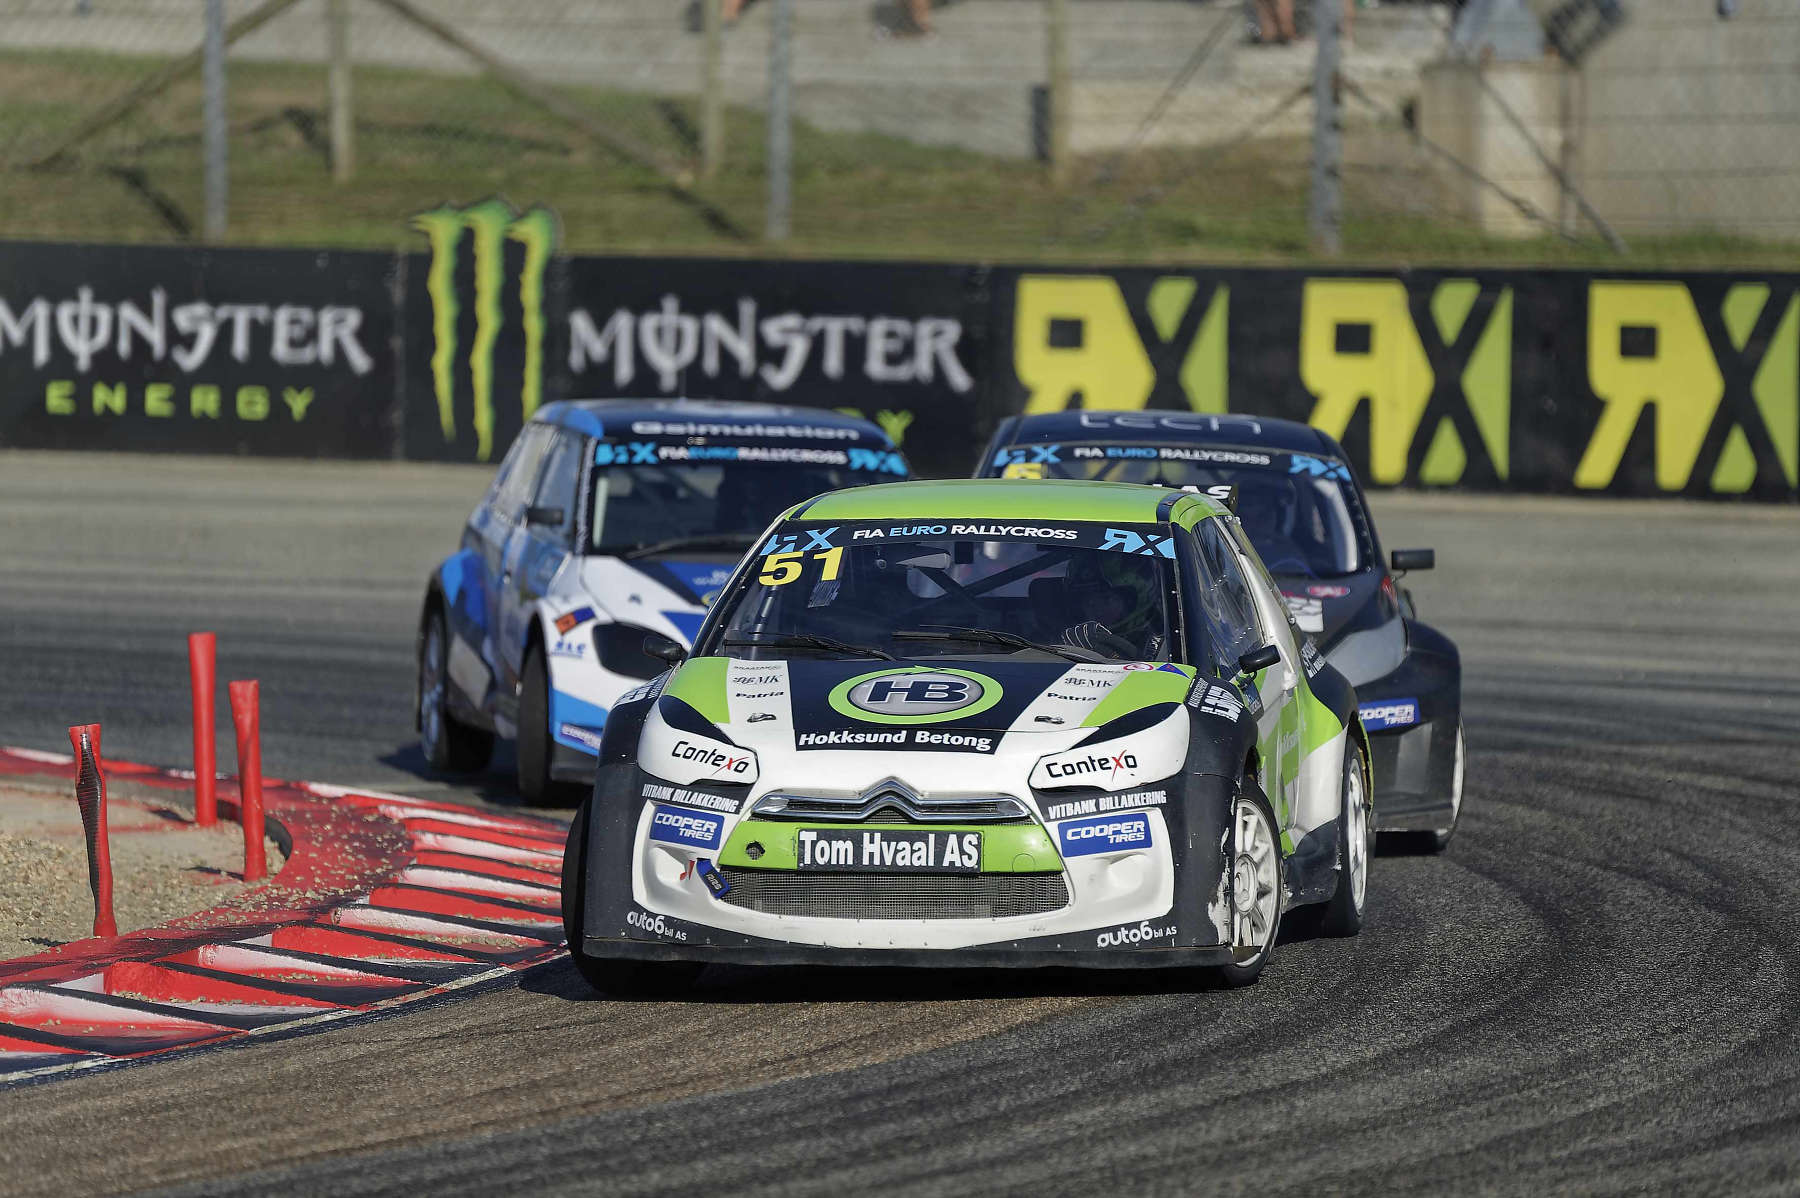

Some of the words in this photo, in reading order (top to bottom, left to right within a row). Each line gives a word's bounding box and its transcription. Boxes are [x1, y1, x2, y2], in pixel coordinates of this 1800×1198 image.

[0, 285, 374, 376] MONSTER
[568, 293, 975, 393] MONSTER
[45, 380, 315, 421] ENERGY
[1074, 447, 1104, 458] FIA
[1106, 448, 1158, 459] EURO
[1159, 448, 1271, 466] RALLYCROSS
[853, 527, 885, 541] FIA
[889, 524, 947, 538] EURO
[951, 524, 1078, 540] RALLYCROSS
[758, 546, 844, 587] 51
[735, 690, 785, 699] Patria
[865, 679, 969, 704] HB
[1047, 692, 1097, 702] Patria
[799, 730, 908, 746] Hokksund
[915, 730, 993, 751] Betong
[672, 787, 740, 813] BILLAKKERING
[1048, 799, 1097, 820] VITBANK
[1098, 790, 1168, 811] BILLAKKERING
[654, 812, 718, 833] COOPER
[1066, 820, 1145, 841] COOPER
[679, 827, 714, 841] TIRES
[1108, 833, 1145, 844] TIRES
[799, 831, 854, 865] Tom
[862, 832, 936, 867] Hvaal
[942, 833, 979, 868] AS
[675, 930, 687, 941] AS
[1165, 926, 1177, 936] AS
